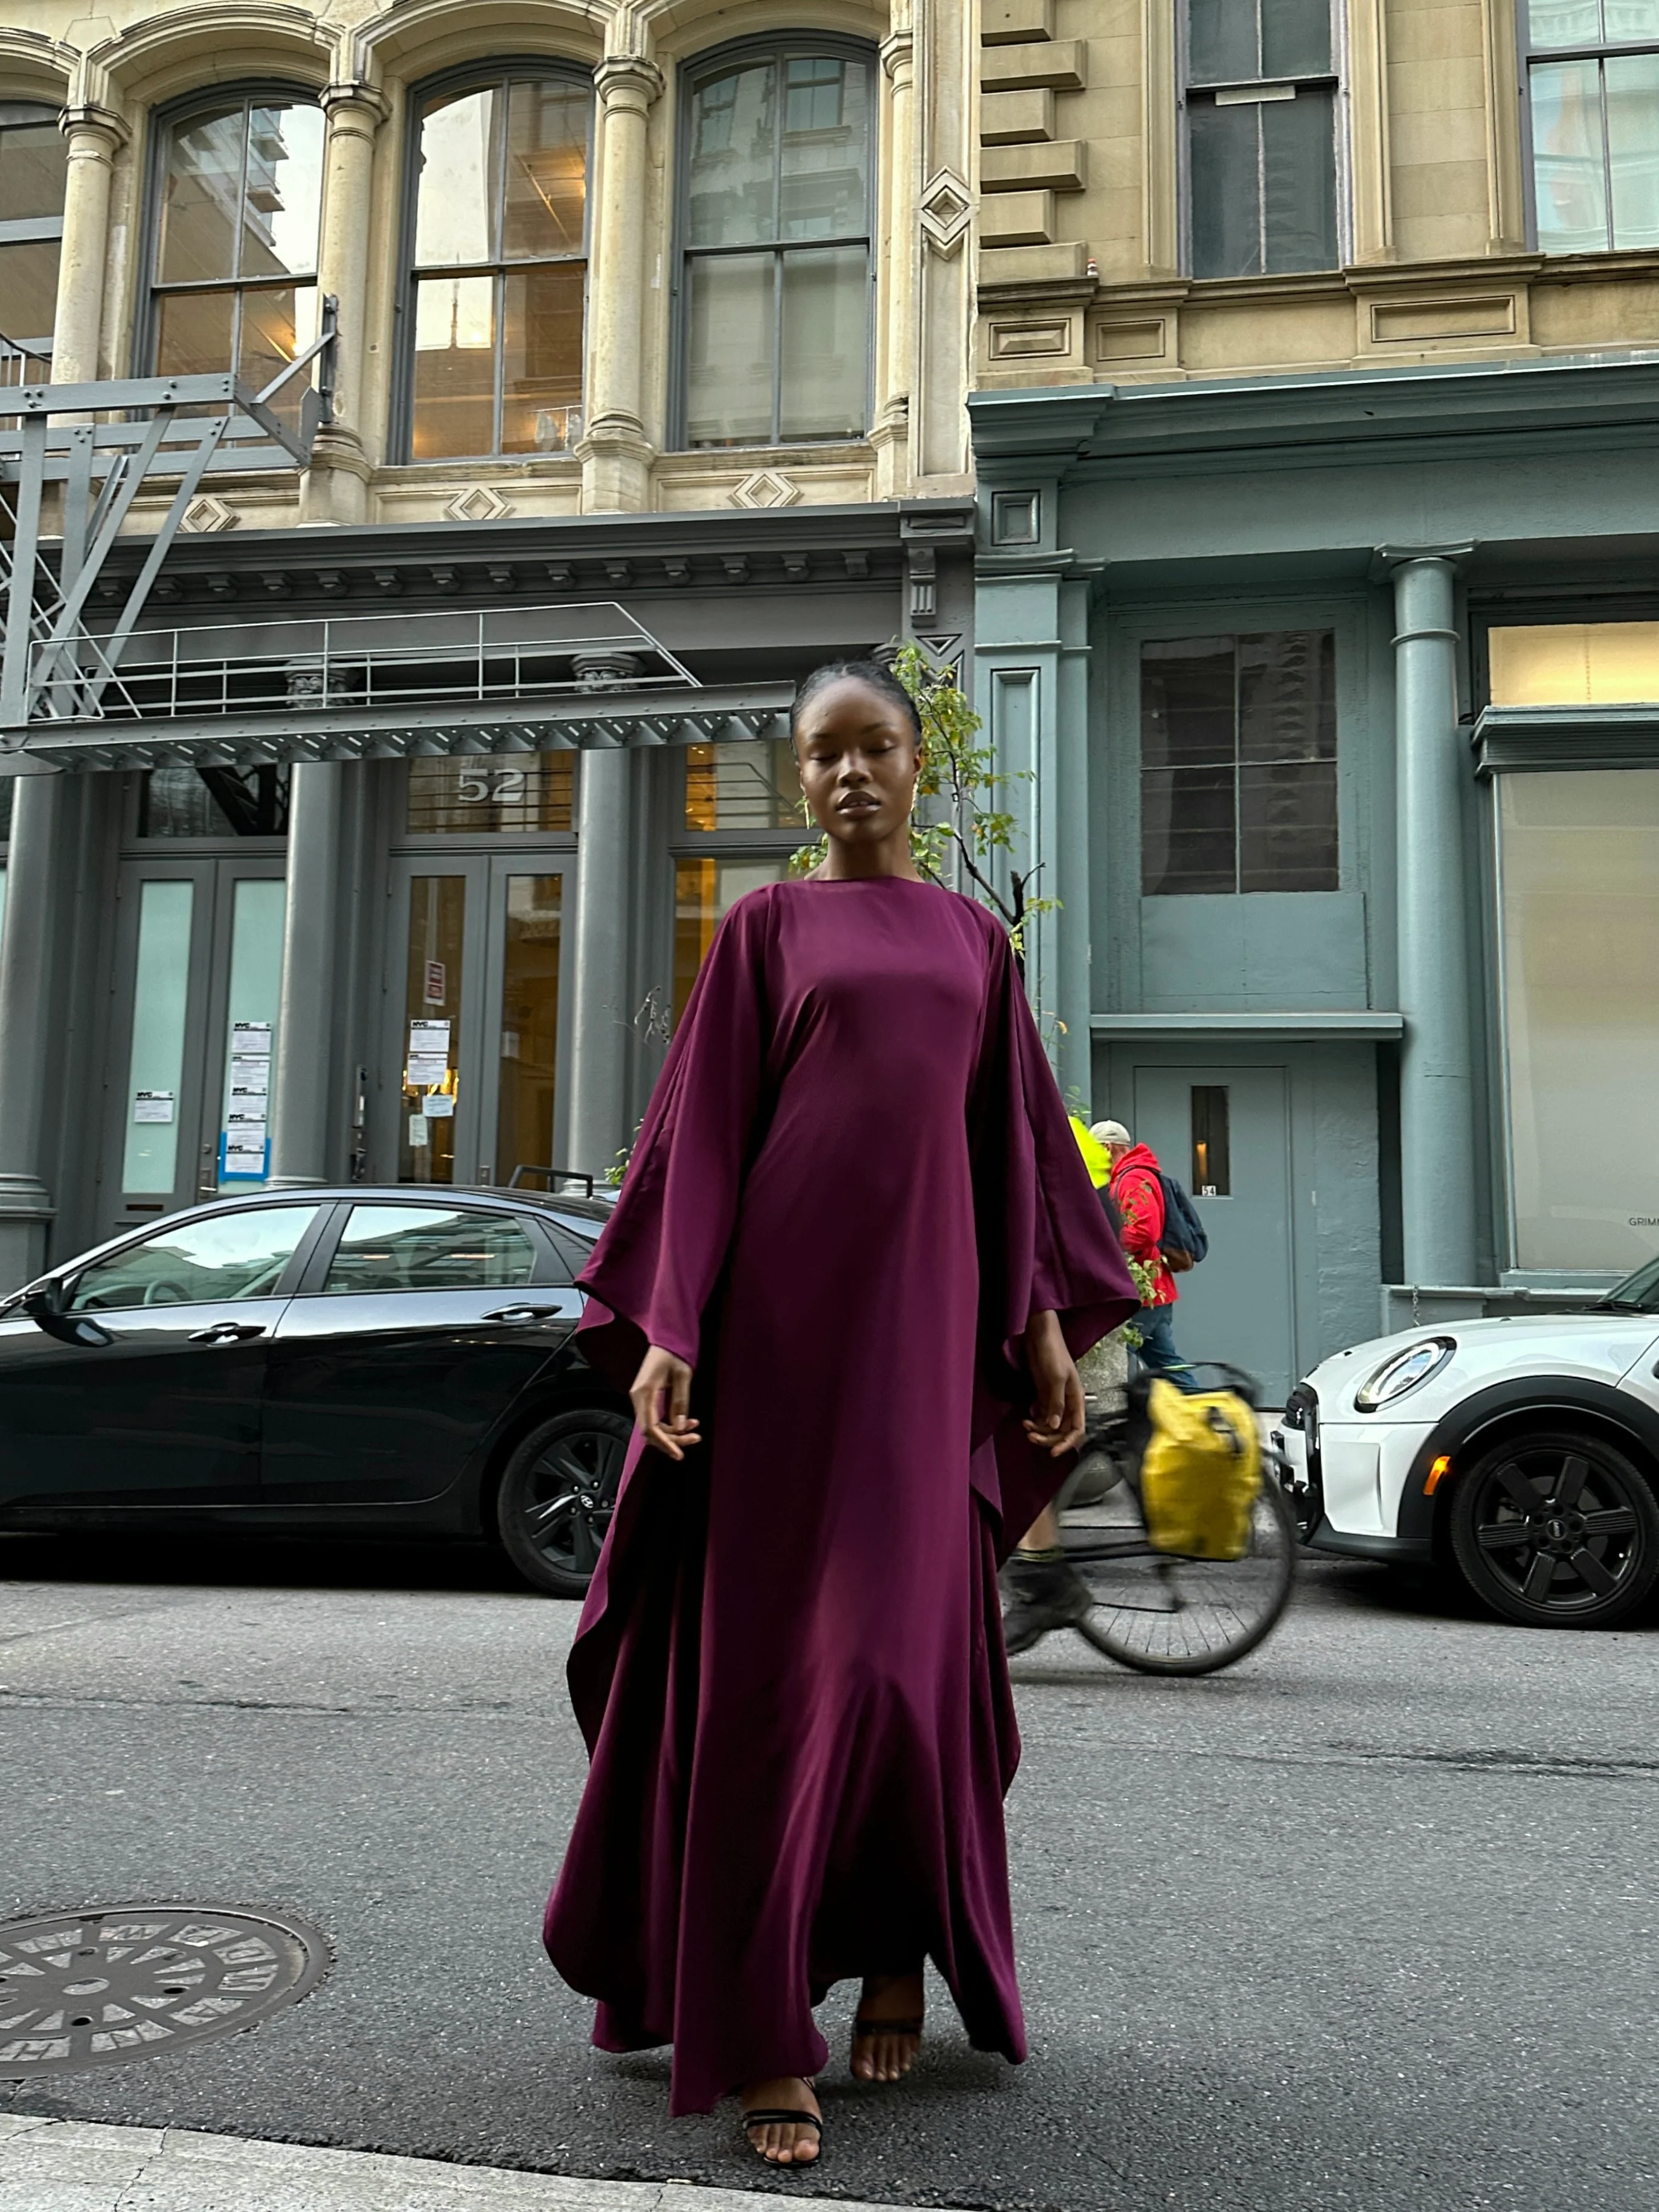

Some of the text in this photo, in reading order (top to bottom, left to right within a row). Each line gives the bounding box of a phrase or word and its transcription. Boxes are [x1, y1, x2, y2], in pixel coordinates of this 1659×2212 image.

[458, 768, 525, 802] 52
[1204, 1186, 1215, 1196] 54
[1629, 1217, 1659, 1226] GRIM
